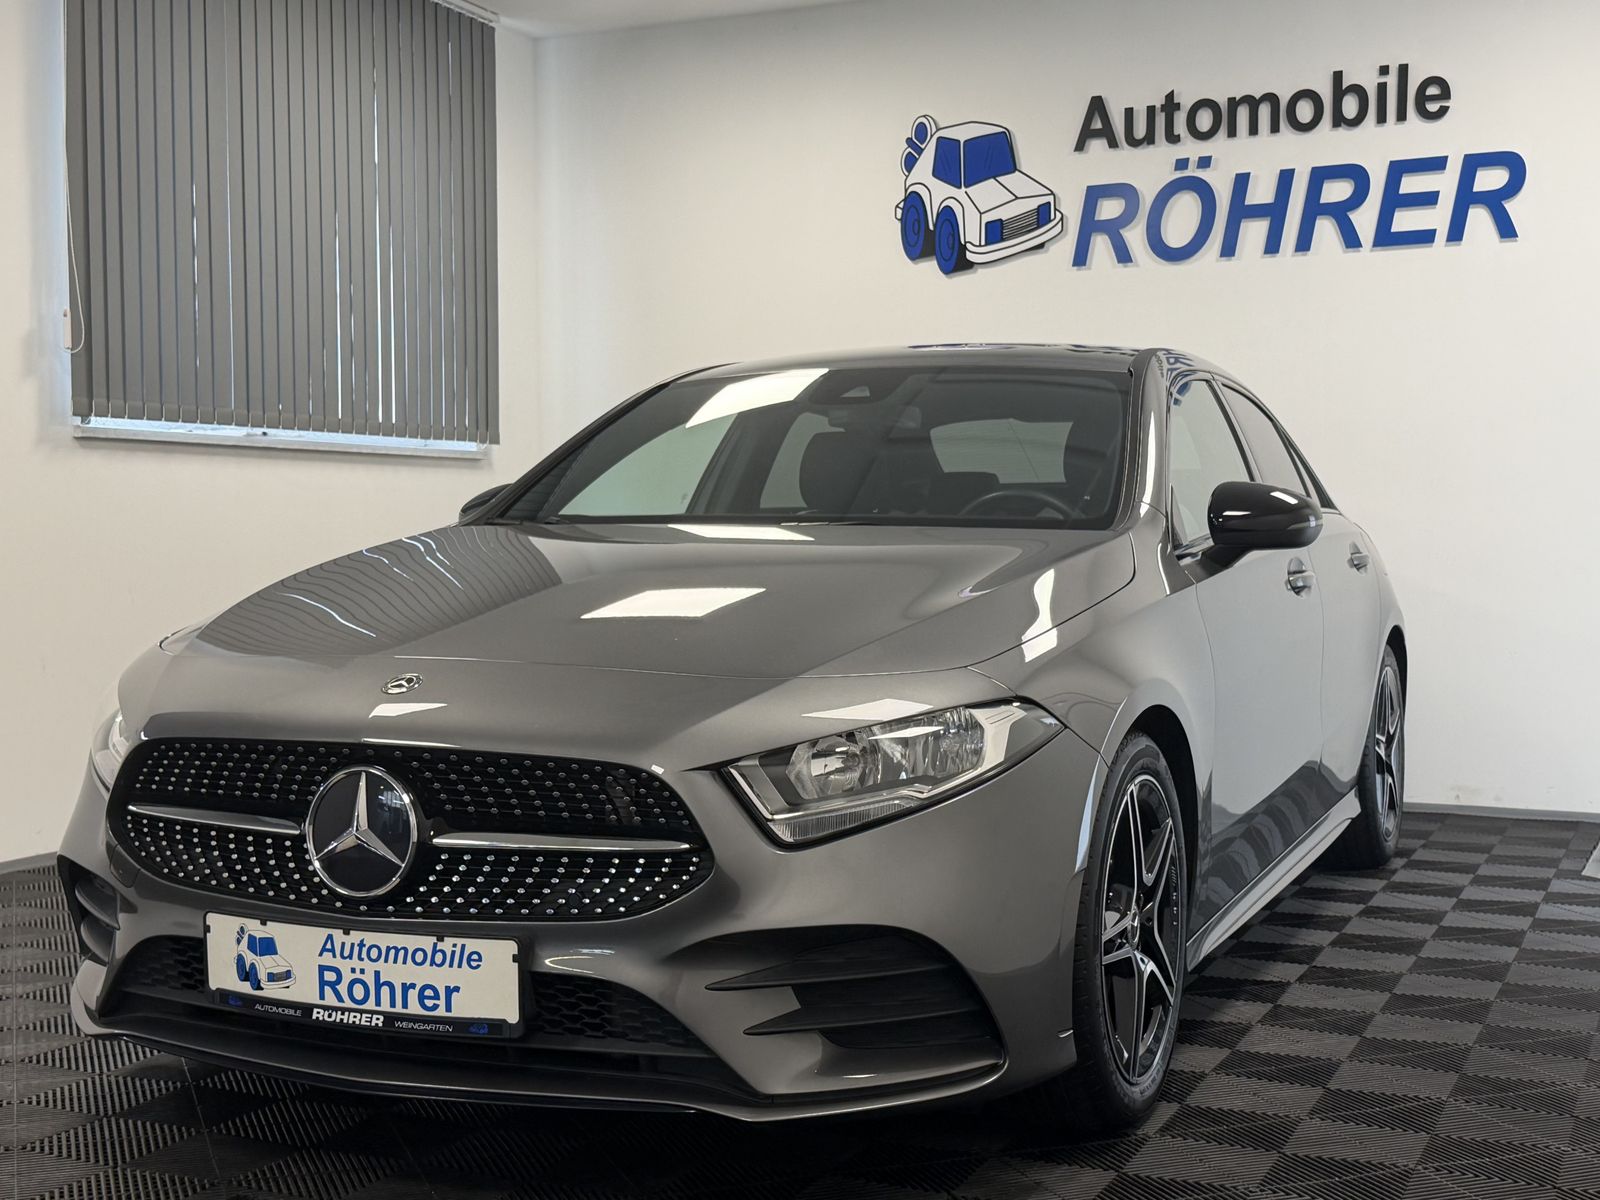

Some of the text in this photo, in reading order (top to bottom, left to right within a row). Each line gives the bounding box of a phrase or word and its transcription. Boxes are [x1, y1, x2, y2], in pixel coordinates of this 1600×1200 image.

[1073, 63, 1452, 153] Automobile
[1072, 150, 1527, 268] RÖHRER
[318, 934, 483, 970] Automobile
[317, 964, 461, 1013] Röhrer
[254, 1003, 453, 1032] AUTOMOBILE RÖHRER WEINGARTEN
